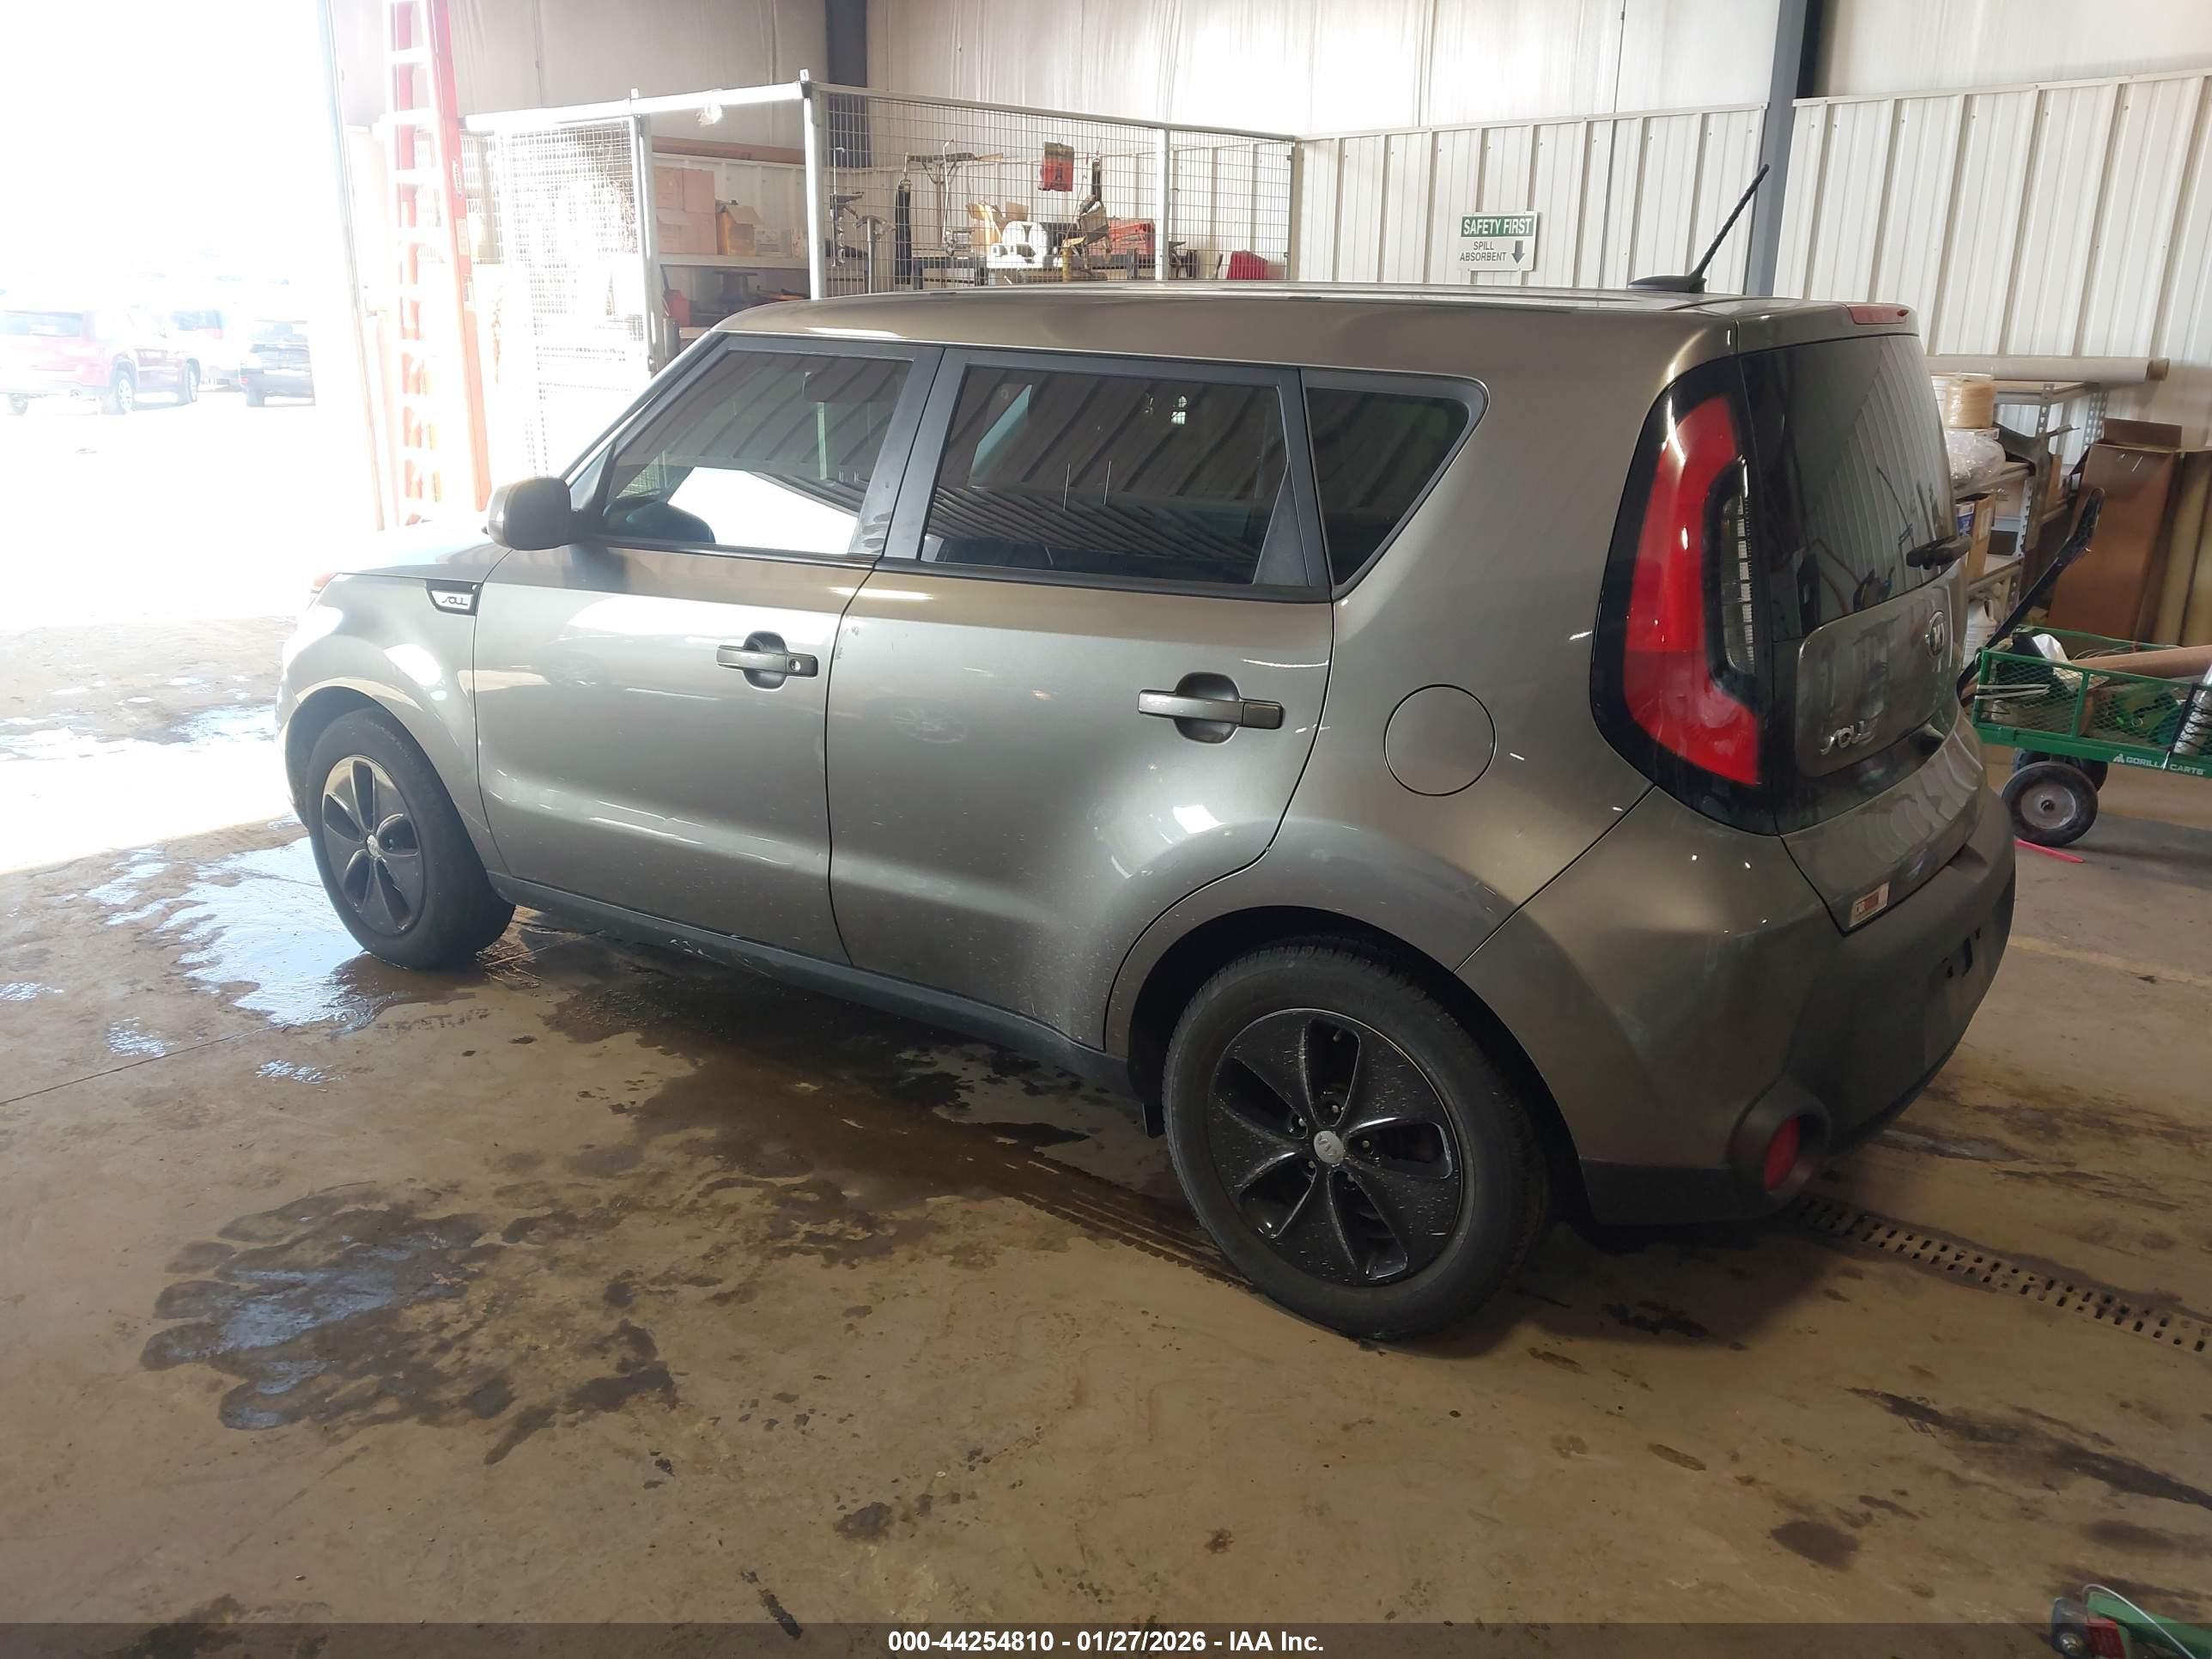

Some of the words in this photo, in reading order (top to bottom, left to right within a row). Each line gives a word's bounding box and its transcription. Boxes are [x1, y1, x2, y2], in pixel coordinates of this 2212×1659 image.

[1463, 218, 1502, 235] SAFETY
[1503, 218, 1533, 234] FIRST
[1473, 241, 1494, 250] SPILL
[1460, 252, 1506, 262] ABSORBENT
[2125, 757, 2167, 769] GORILLA
[2169, 763, 2204, 775] CARTS
